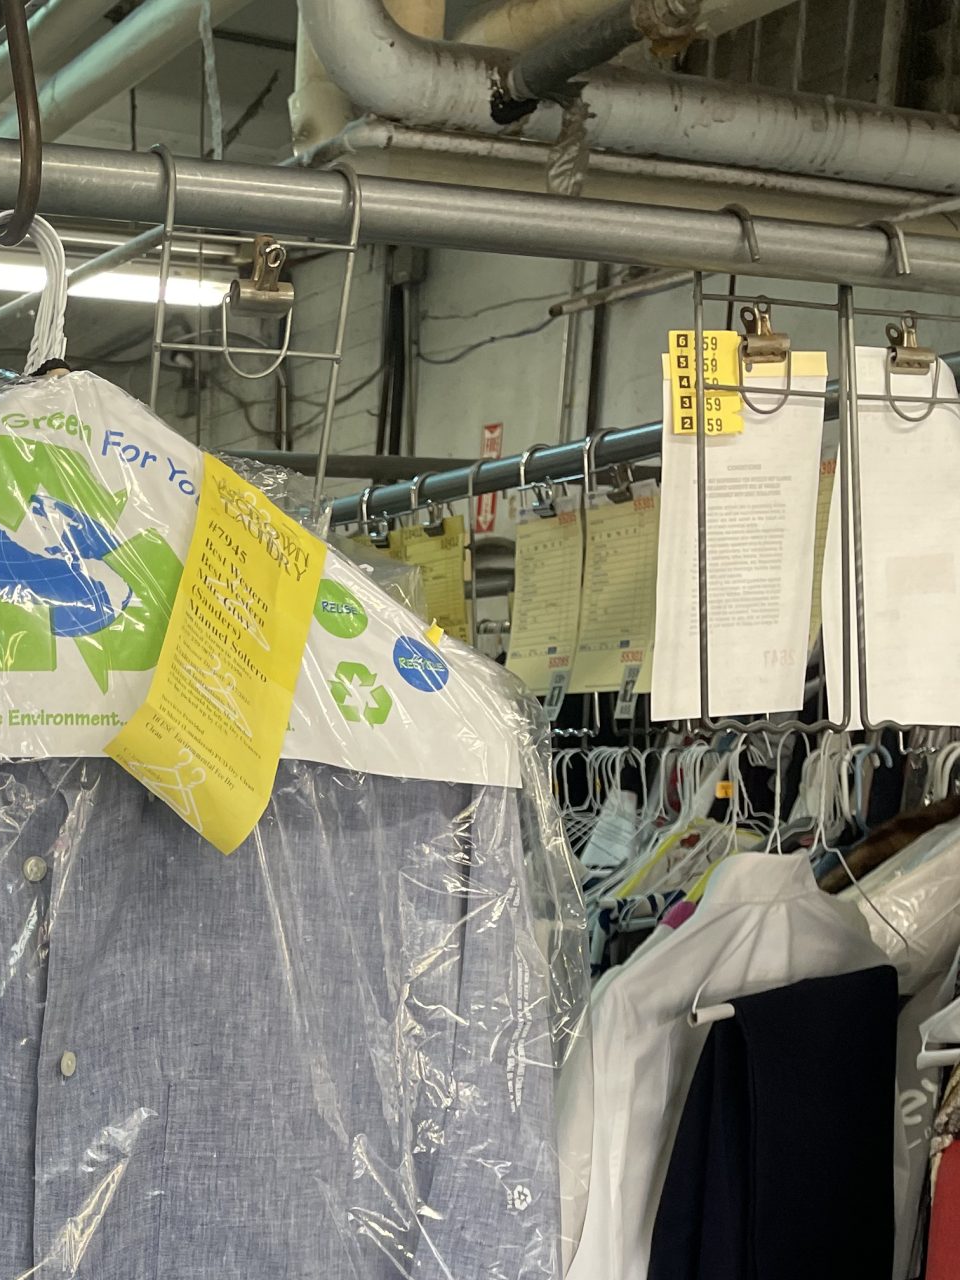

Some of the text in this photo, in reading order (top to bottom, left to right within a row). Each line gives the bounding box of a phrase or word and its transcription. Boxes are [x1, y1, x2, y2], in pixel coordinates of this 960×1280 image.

[2, 410, 93, 442] Green
[101, 430, 158, 470] For
[163, 460, 200, 506] Yo
[207, 516, 248, 565] #7945
[200, 552, 225, 581] Best
[225, 577, 266, 627] Western
[204, 536, 227, 567] Best
[229, 561, 268, 613] Western
[188, 597, 228, 645] Manuel
[190, 583, 244, 639] (Sanders)
